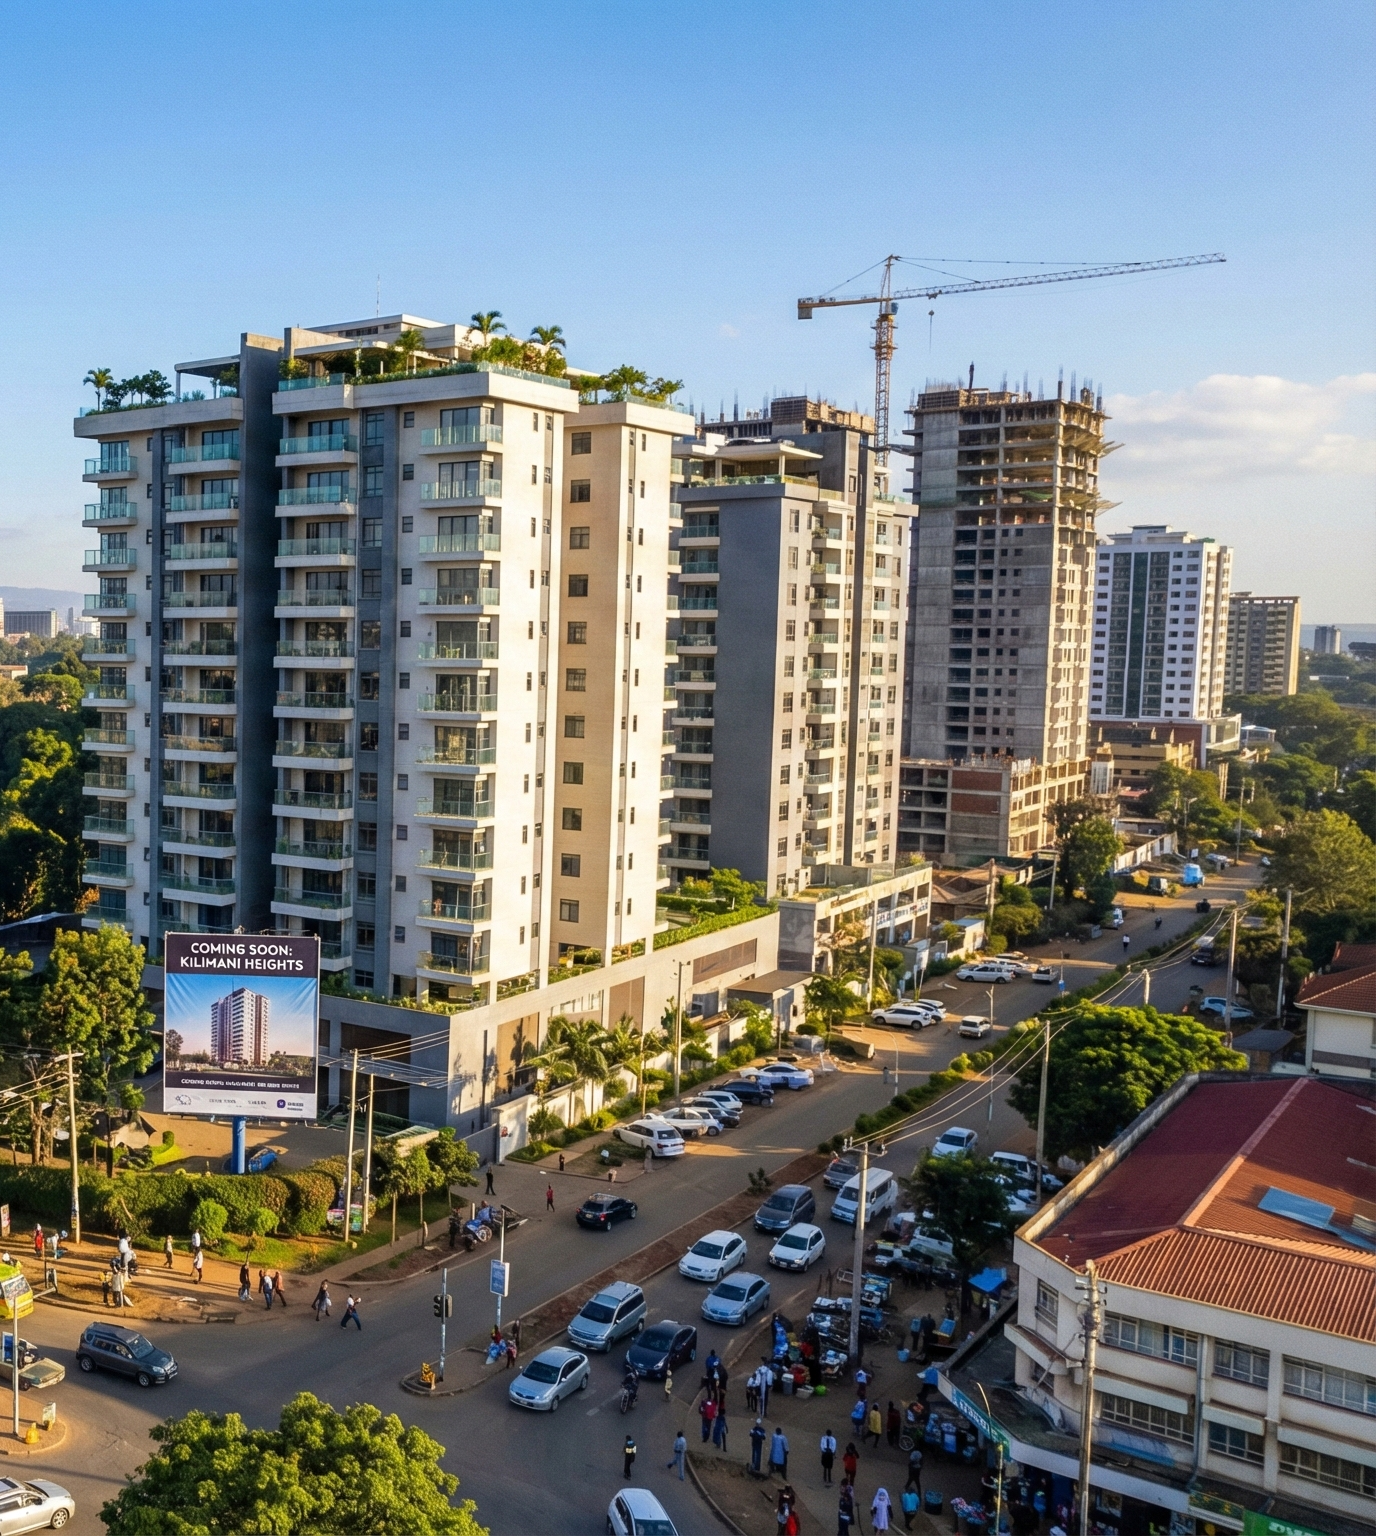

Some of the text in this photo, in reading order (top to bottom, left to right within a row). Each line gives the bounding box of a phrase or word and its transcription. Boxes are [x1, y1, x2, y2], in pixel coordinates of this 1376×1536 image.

[190, 942, 293, 956] COMING SOON:
[180, 956, 304, 971] KILIMANI HEIGHTS
